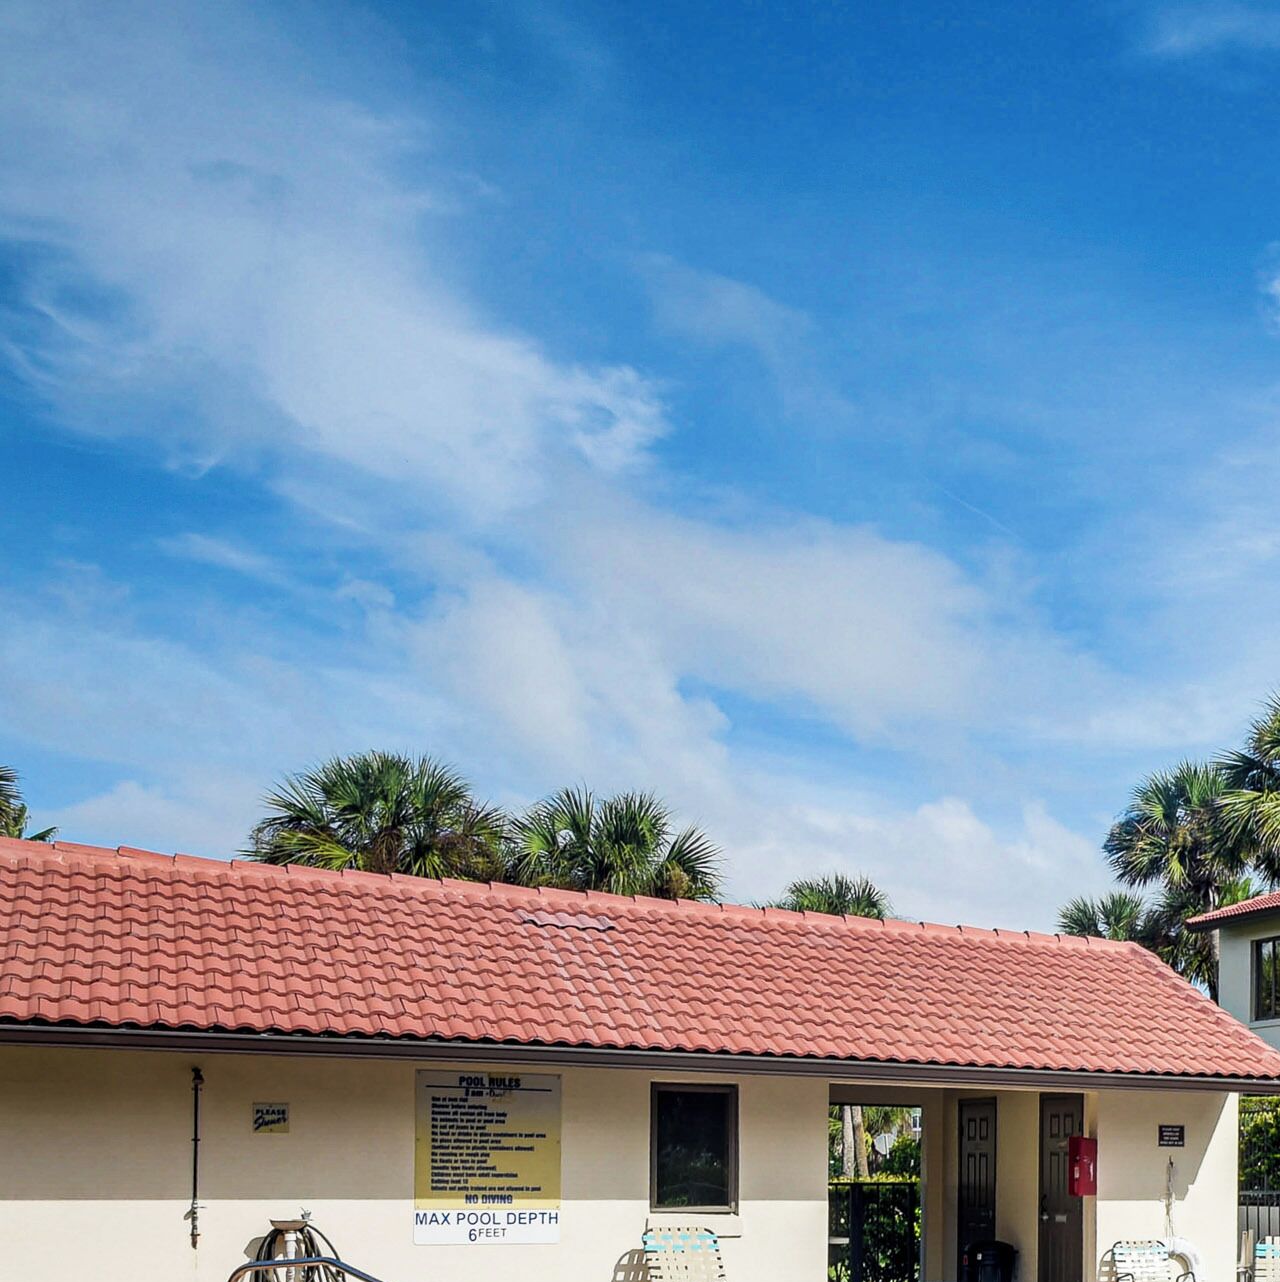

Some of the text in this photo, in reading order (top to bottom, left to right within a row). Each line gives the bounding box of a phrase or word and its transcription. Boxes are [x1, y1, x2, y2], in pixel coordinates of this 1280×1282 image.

[459, 1076, 521, 1088] POOL RULES
[465, 1194, 513, 1204] NO DIVING
[415, 1212, 559, 1225] MAX POOL DEPTH
[468, 1228, 507, 1241] 6 FEET
